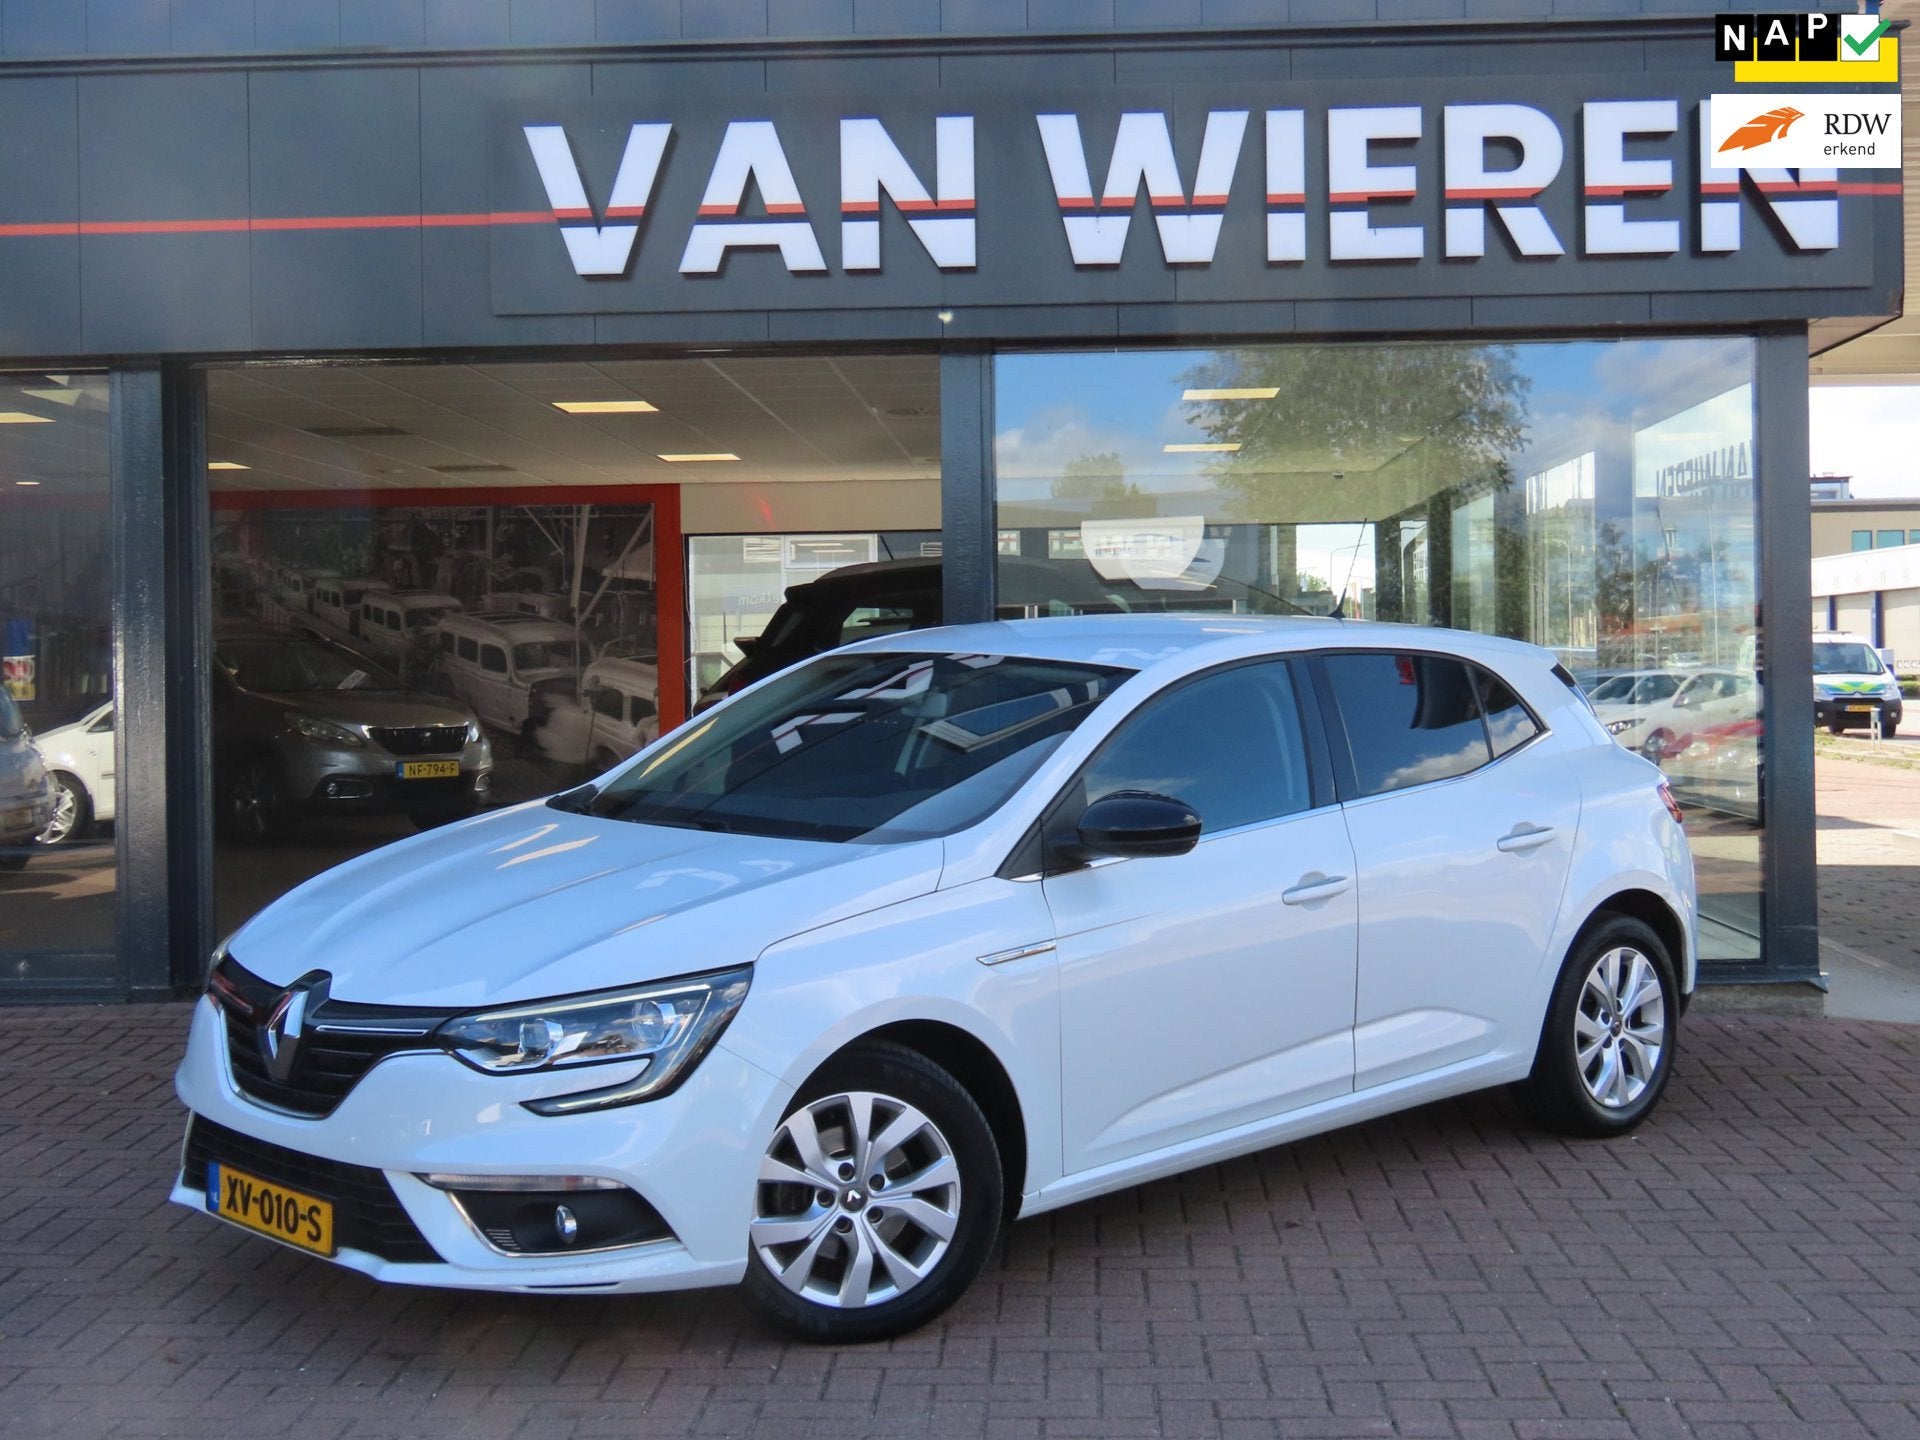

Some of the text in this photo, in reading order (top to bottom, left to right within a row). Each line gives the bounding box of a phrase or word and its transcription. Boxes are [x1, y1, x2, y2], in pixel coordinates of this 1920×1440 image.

[523, 99, 1839, 275] VAN WIEREN
[226, 1174, 322, 1243] XV-010-S
